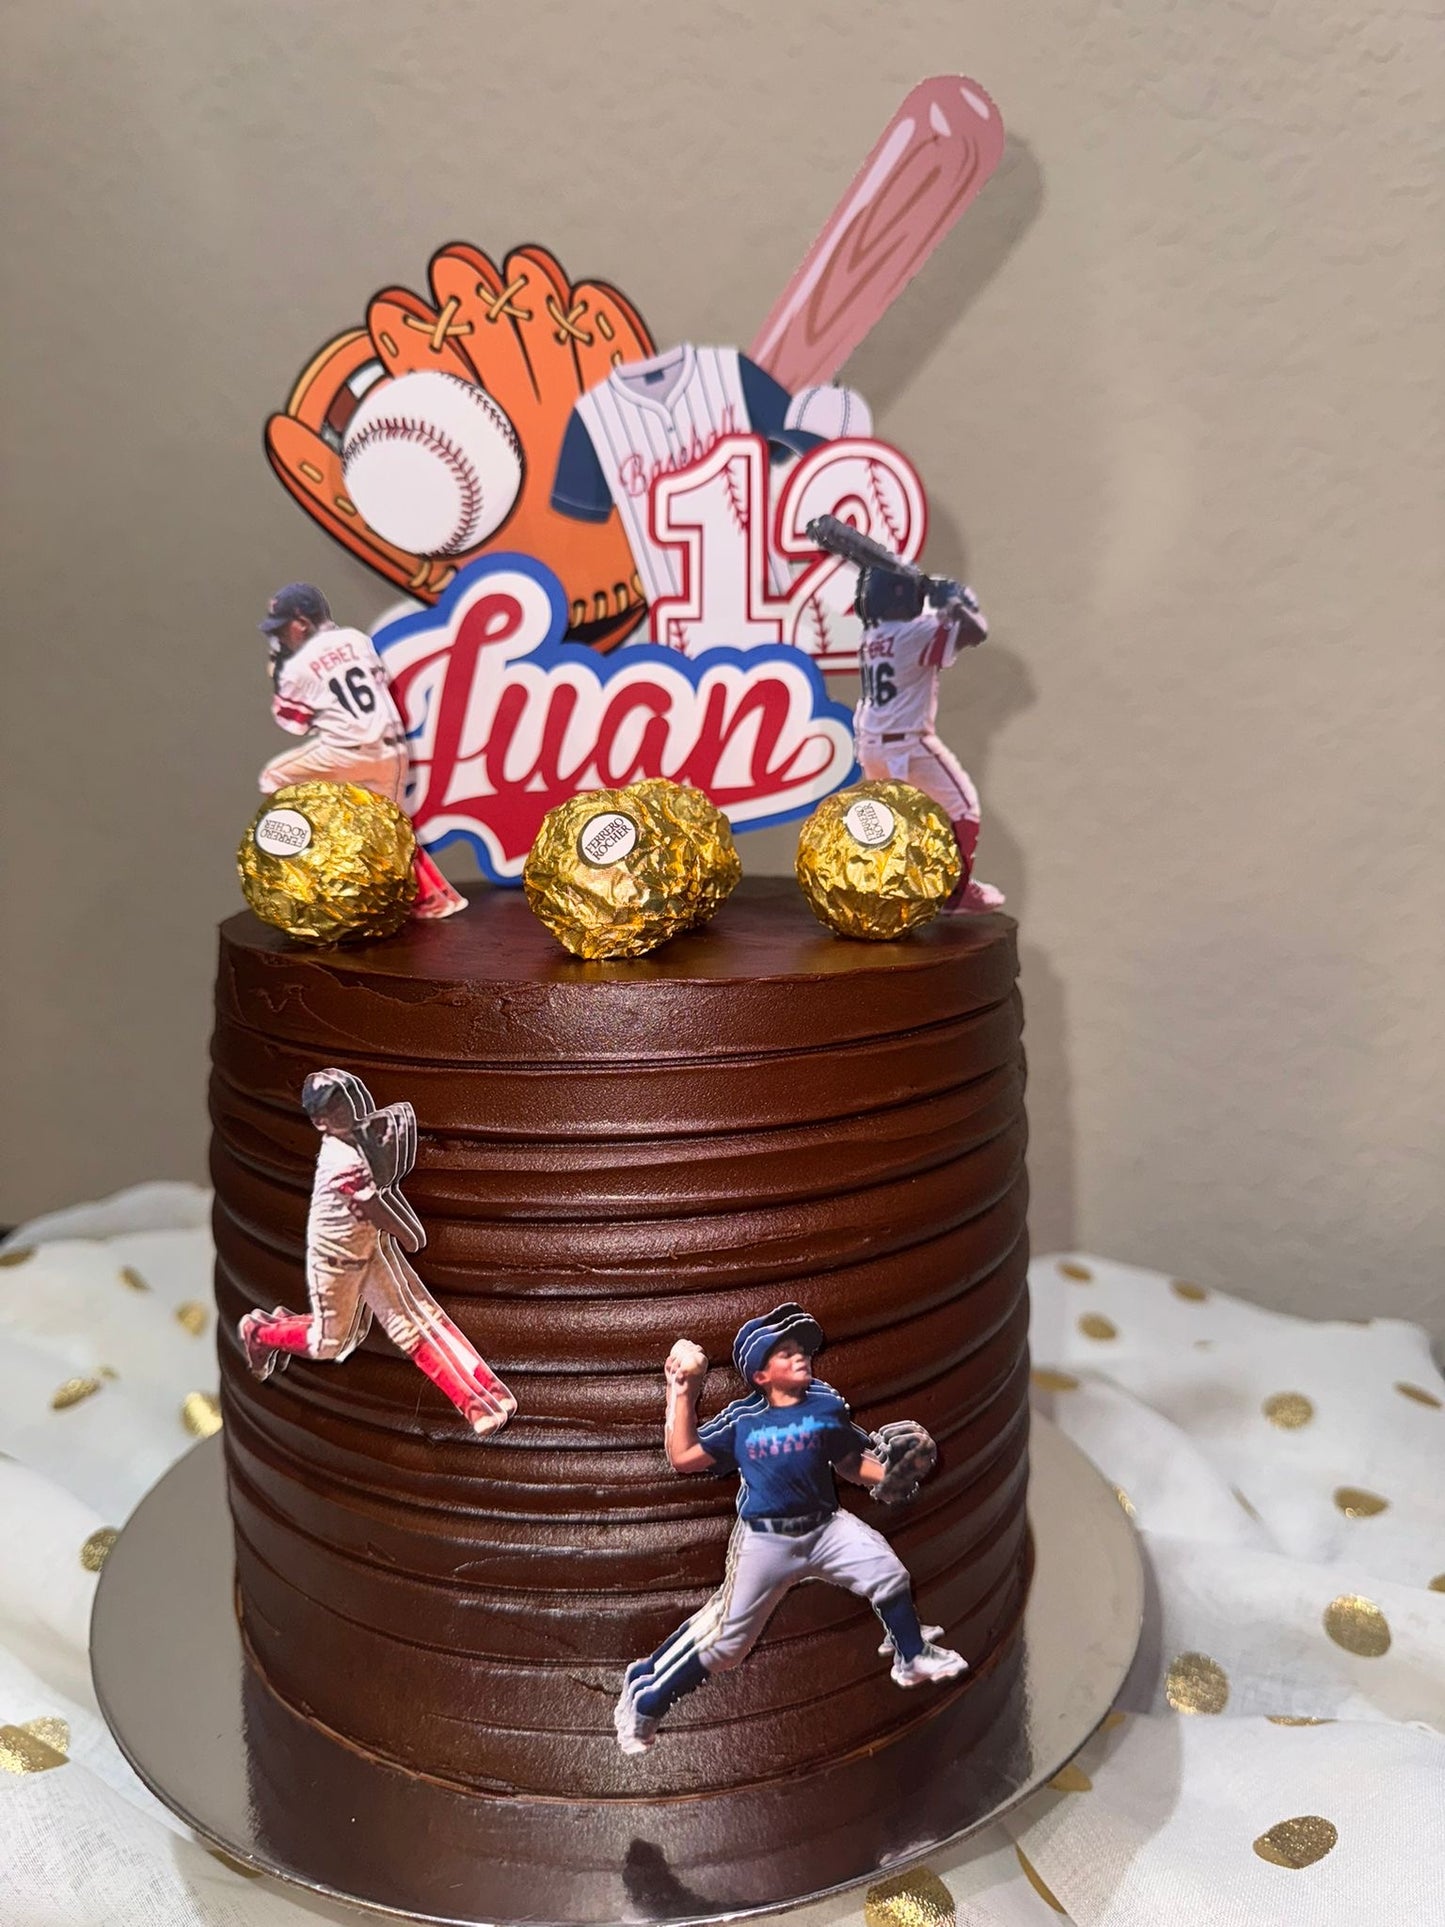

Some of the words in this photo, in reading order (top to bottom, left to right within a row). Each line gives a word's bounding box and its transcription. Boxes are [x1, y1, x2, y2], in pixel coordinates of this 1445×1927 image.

[649, 432, 928, 676] 12
[309, 643, 361, 679] PEREZ
[328, 666, 376, 720] 16
[390, 593, 835, 863] Juan
[260, 828, 305, 848] FERRERO
[264, 819, 309, 839] ROCHER
[584, 817, 625, 854] FERRERO
[854, 805, 876, 842] FERRERO
[862, 803, 885, 839] ROCHER
[592, 824, 632, 861] ROCHER
